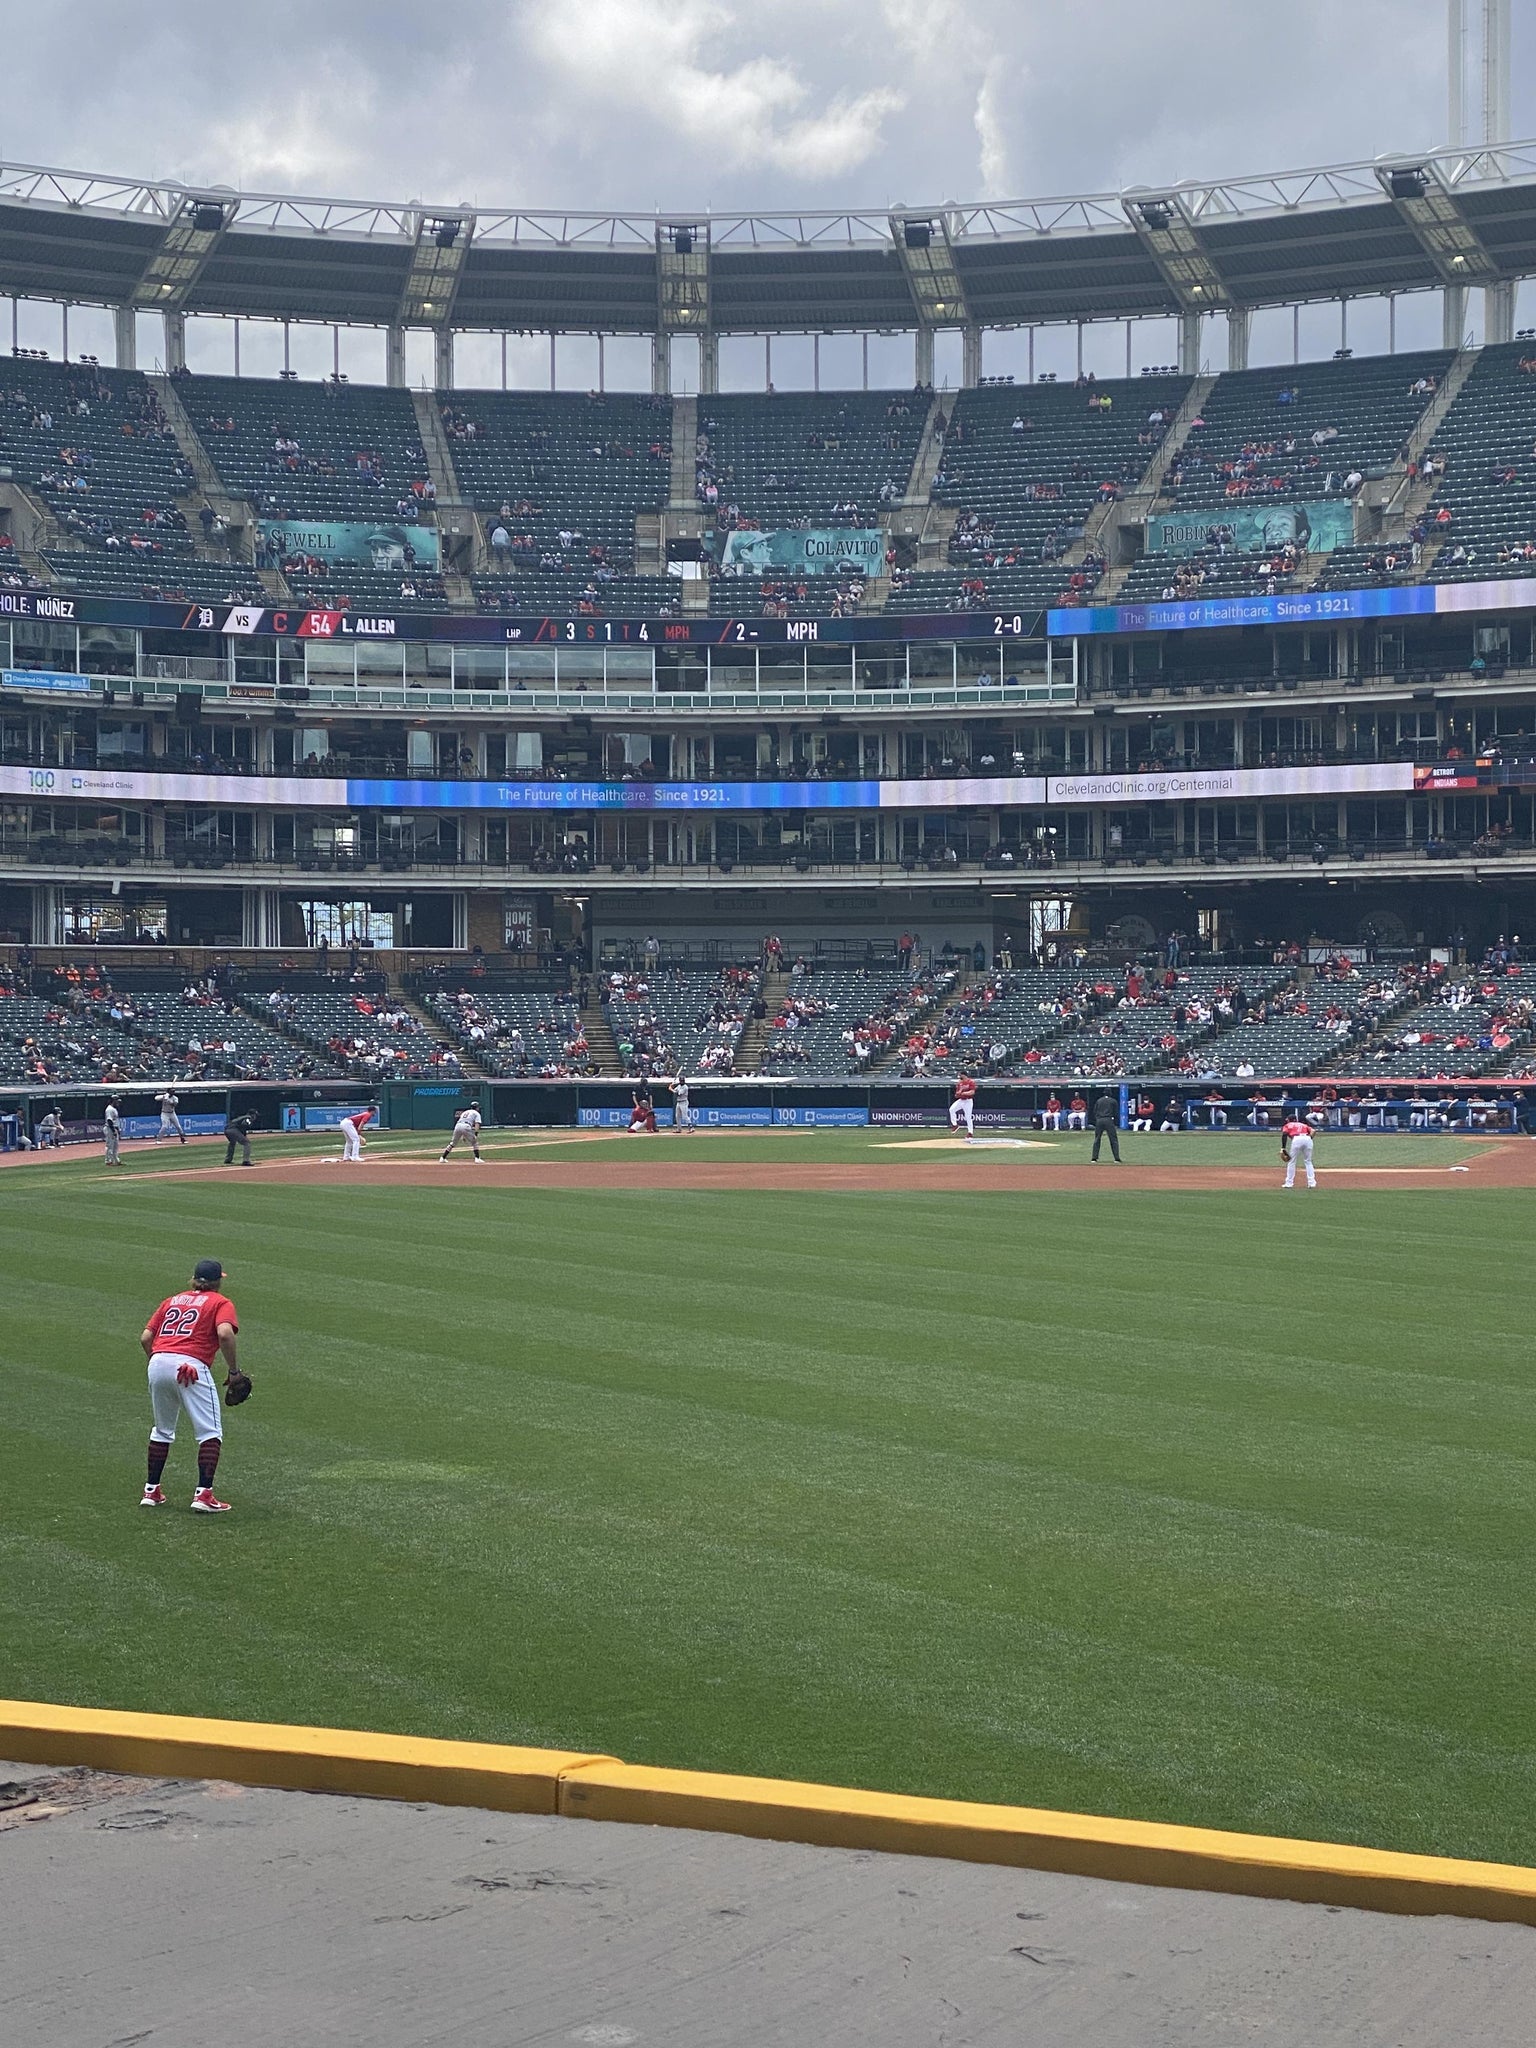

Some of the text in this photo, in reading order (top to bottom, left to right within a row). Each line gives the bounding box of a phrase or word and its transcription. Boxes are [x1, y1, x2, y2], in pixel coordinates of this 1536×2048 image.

[271, 529, 336, 549] SEWELL
[1162, 523, 1238, 544] ROBINN
[805, 539, 879, 557] COLAVITO
[36, 596, 75, 618] NÚÑEZ
[1123, 598, 1355, 625] The Future of Healthcare. Since 1921.
[236, 614, 249, 627] VS
[273, 613, 288, 632] C
[310, 614, 395, 635] 54 L. ALLEN
[566, 622, 575, 640] 3
[587, 625, 595, 638] S
[604, 622, 611, 640] 1
[639, 623, 648, 641] 4
[665, 625, 690, 639] MPH
[786, 622, 818, 640] MPH
[994, 615, 1022, 635] 2-0
[506, 628, 521, 639] LHP
[28, 770, 55, 788] 100
[1432, 768, 1456, 776] DETROIT
[83, 781, 133, 789] Cleveland Clinic
[1055, 777, 1233, 795] ClevelandClinic.org/Centennial
[1434, 778, 1458, 787] INDIANS
[497, 788, 730, 801] The Future of Healthcare. Since 1921.
[505, 911, 532, 927] HOME
[414, 1087, 461, 1096] PROGRESSIVE
[582, 1109, 600, 1120] 100
[720, 1112, 770, 1120] Cleveland Clinic
[778, 1108, 796, 1120] 100
[816, 1112, 846, 1120] Cleveland
[159, 1307, 200, 1337] 22
